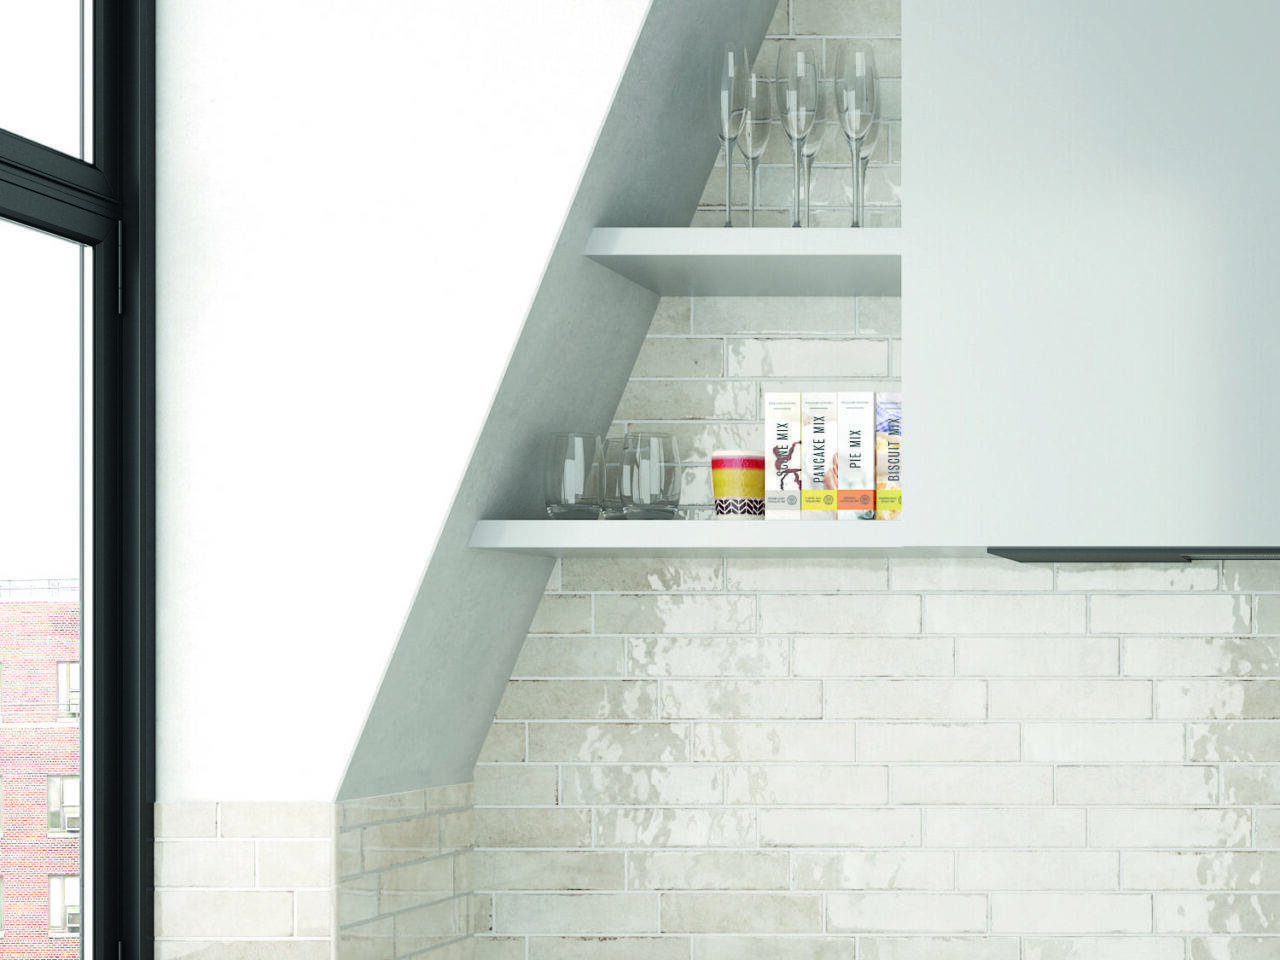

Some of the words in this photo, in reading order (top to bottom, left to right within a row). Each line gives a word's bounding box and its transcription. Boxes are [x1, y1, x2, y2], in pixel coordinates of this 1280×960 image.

[776, 422, 789, 441] MIX
[813, 415, 825, 434] MIX
[887, 417, 900, 436] MIX
[850, 429, 861, 448] MIX
[776, 444, 789, 476] SCONE
[813, 438, 826, 483] PANCAKE
[850, 451, 862, 469] PIE
[887, 440, 900, 481] BISCUIT
